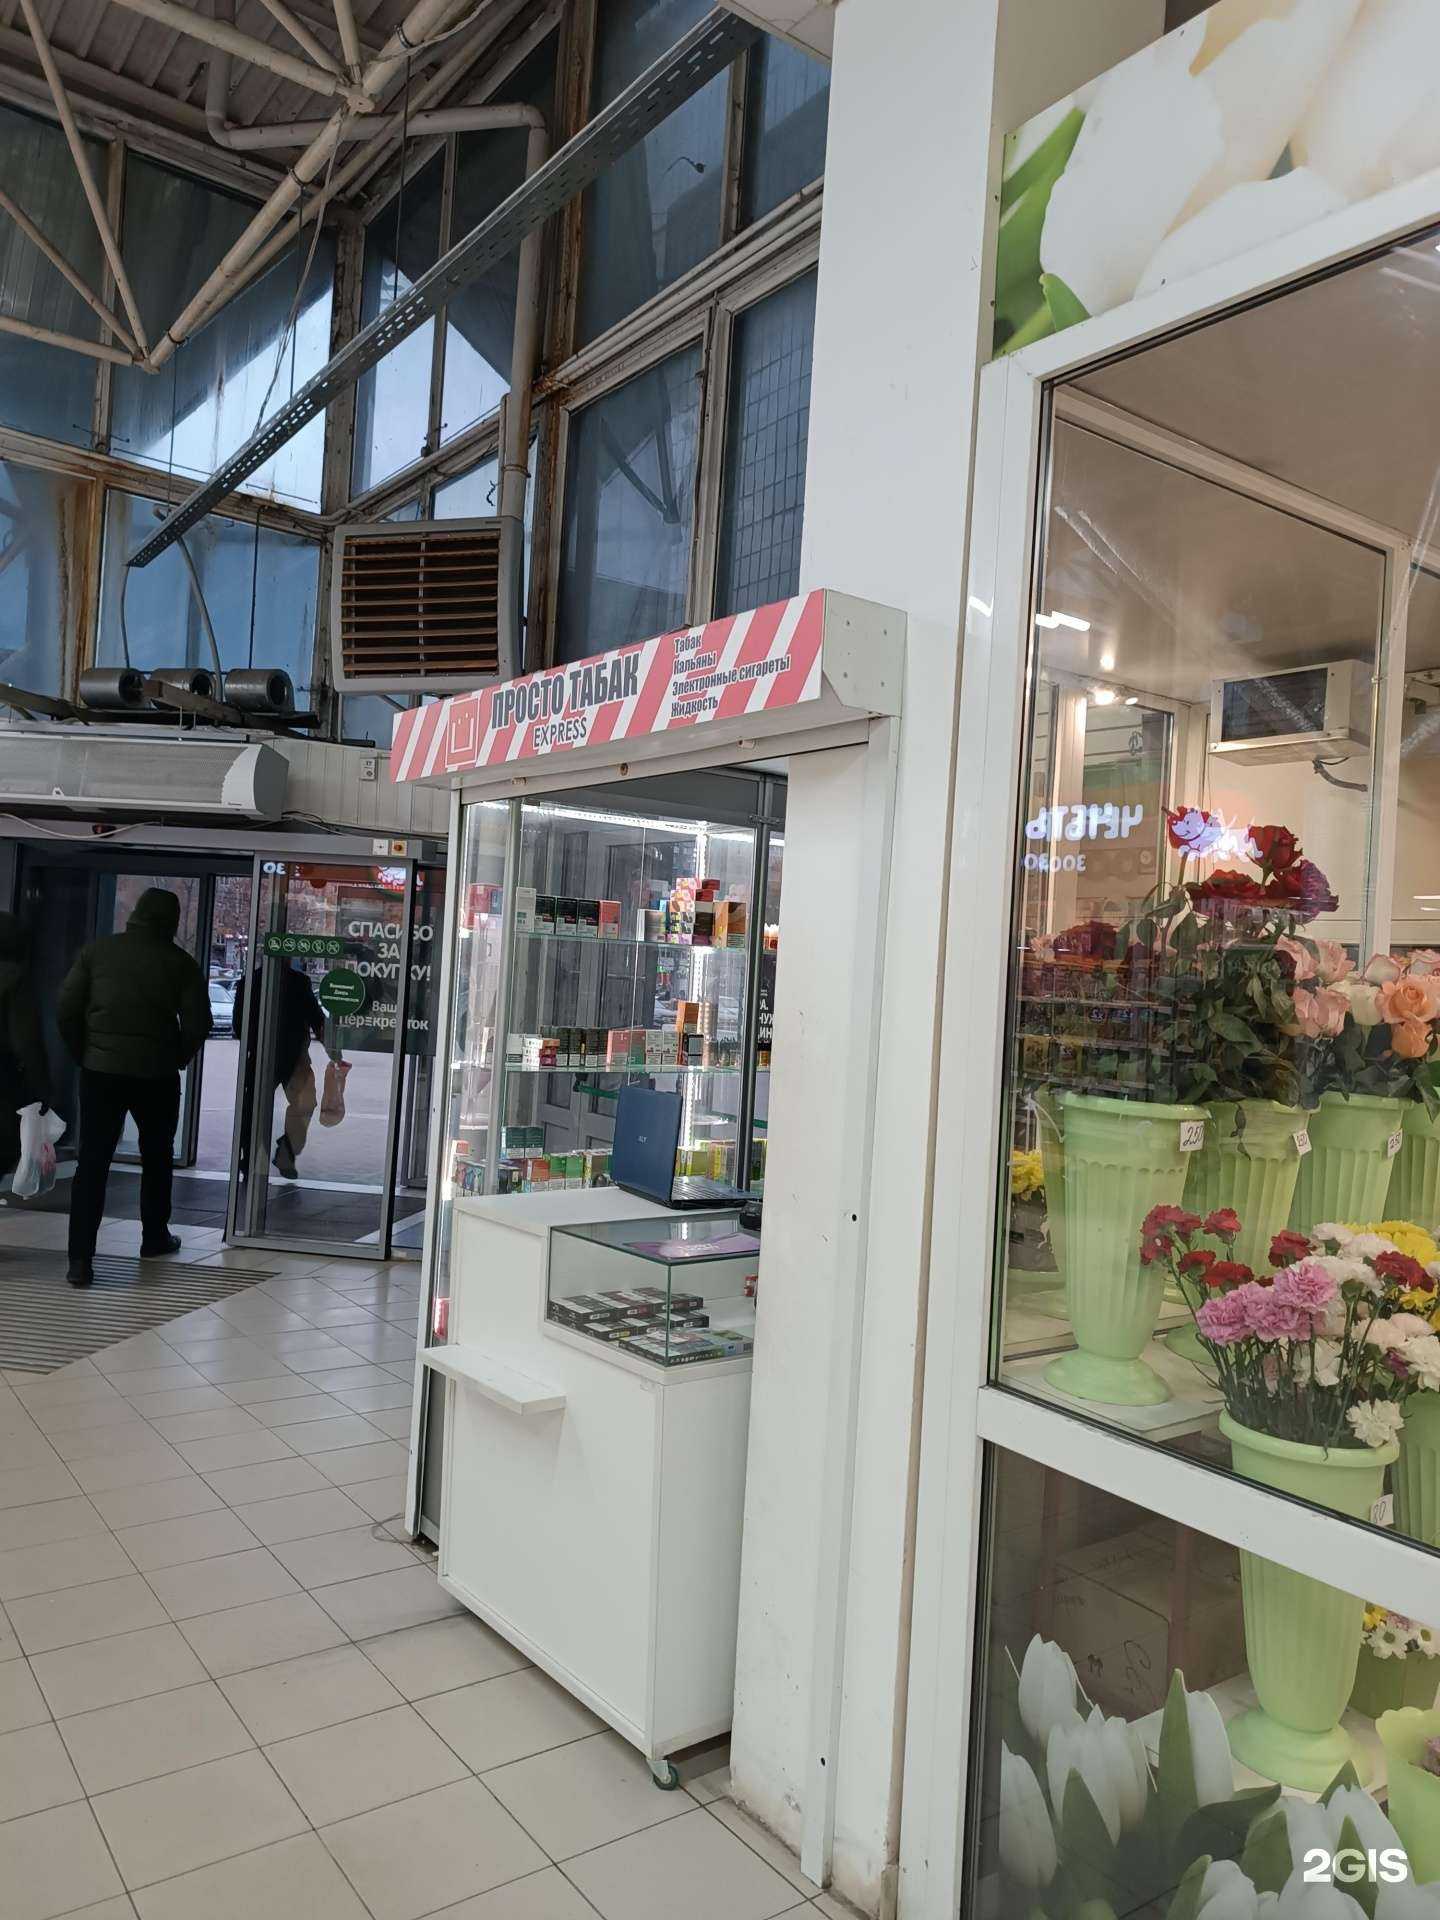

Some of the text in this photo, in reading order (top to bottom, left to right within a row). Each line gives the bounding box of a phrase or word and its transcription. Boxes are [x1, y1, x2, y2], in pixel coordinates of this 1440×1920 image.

[674, 634, 702, 654] Табак
[673, 652, 717, 675] Кальяны
[672, 656, 790, 697] Электронные сигареты
[491, 652, 640, 730] ПРОСТО ТАБАК
[671, 696, 719, 718] Жидкость
[533, 716, 588, 748] EXPRESS
[377, 942, 400, 959] ЗА
[371, 1000, 398, 1013] Ваш
[339, 1014, 429, 1030] Перекреток
